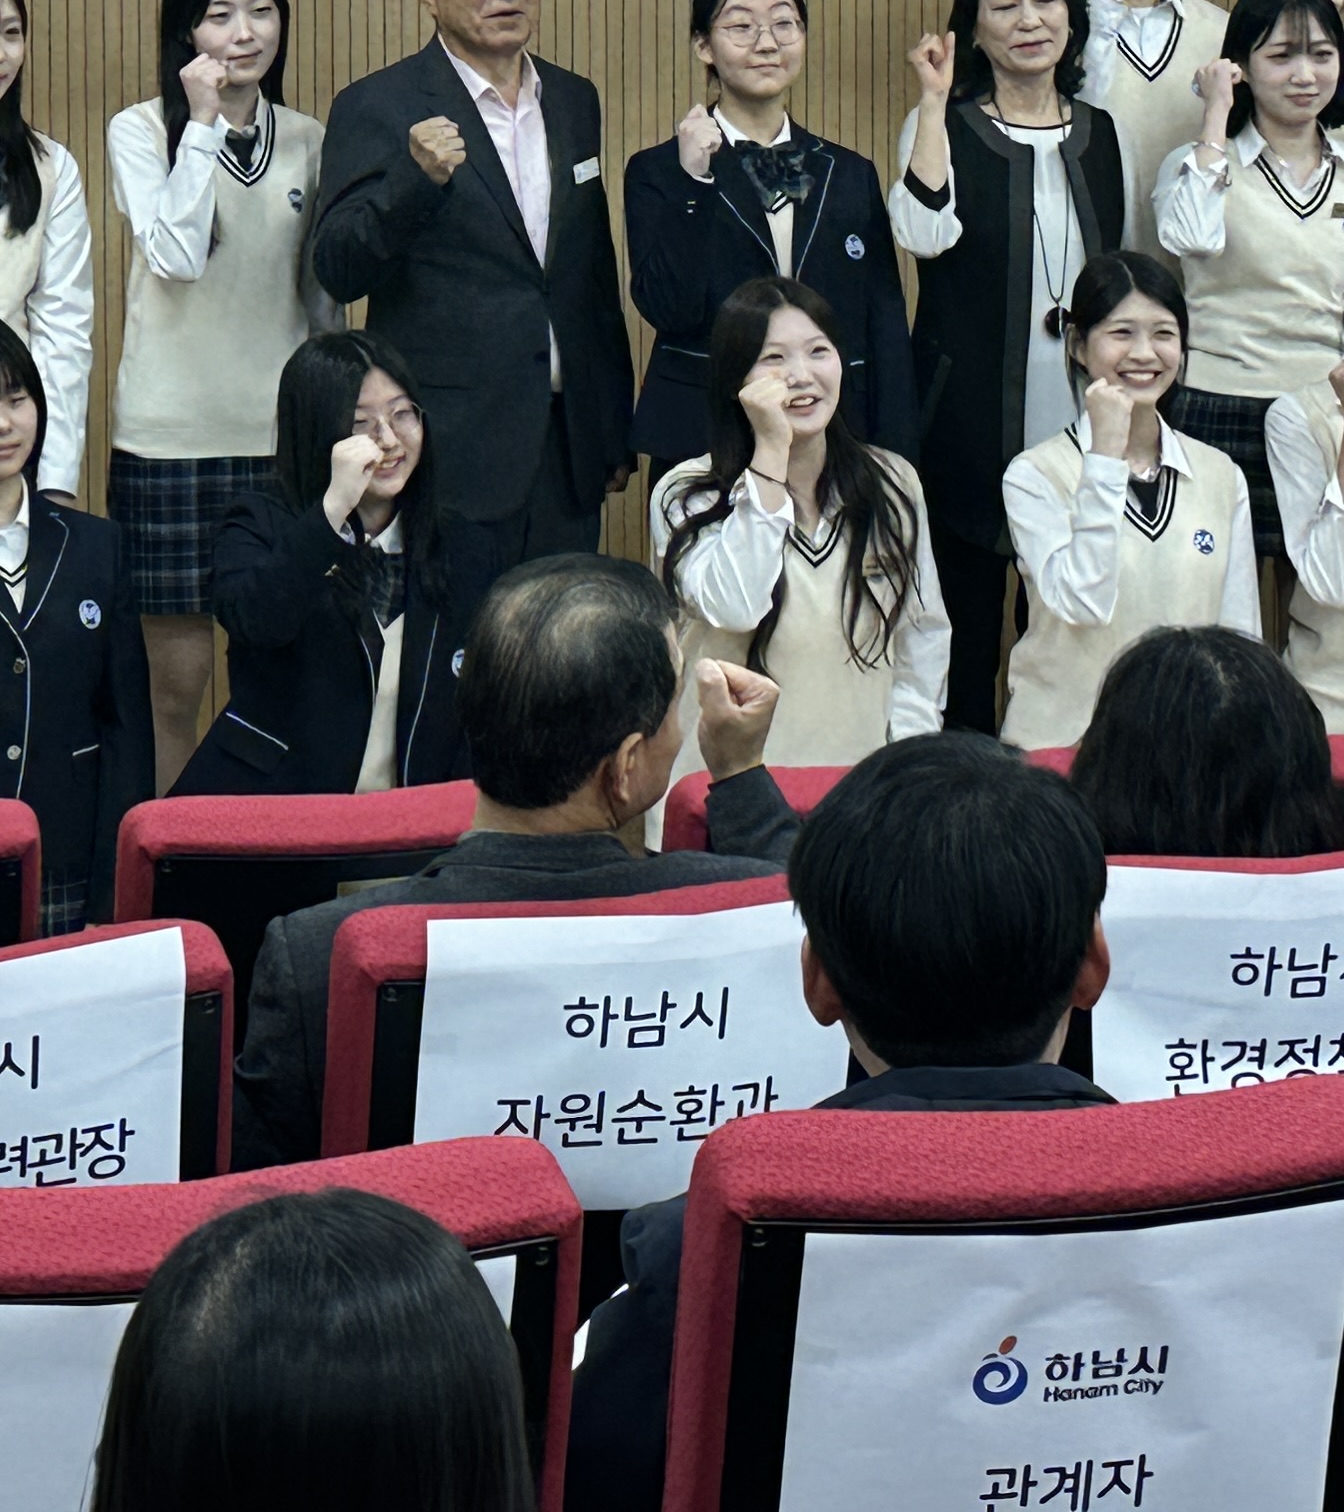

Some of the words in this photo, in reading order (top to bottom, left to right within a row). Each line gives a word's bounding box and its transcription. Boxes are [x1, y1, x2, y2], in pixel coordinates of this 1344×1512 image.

[564, 987, 728, 1048] 하남시
[1045, 1345, 1169, 1381] 하남시
[1044, 1384, 1118, 1402] Hanam
[1124, 1378, 1164, 1395] City
[979, 1454, 1154, 1512] 관계자
